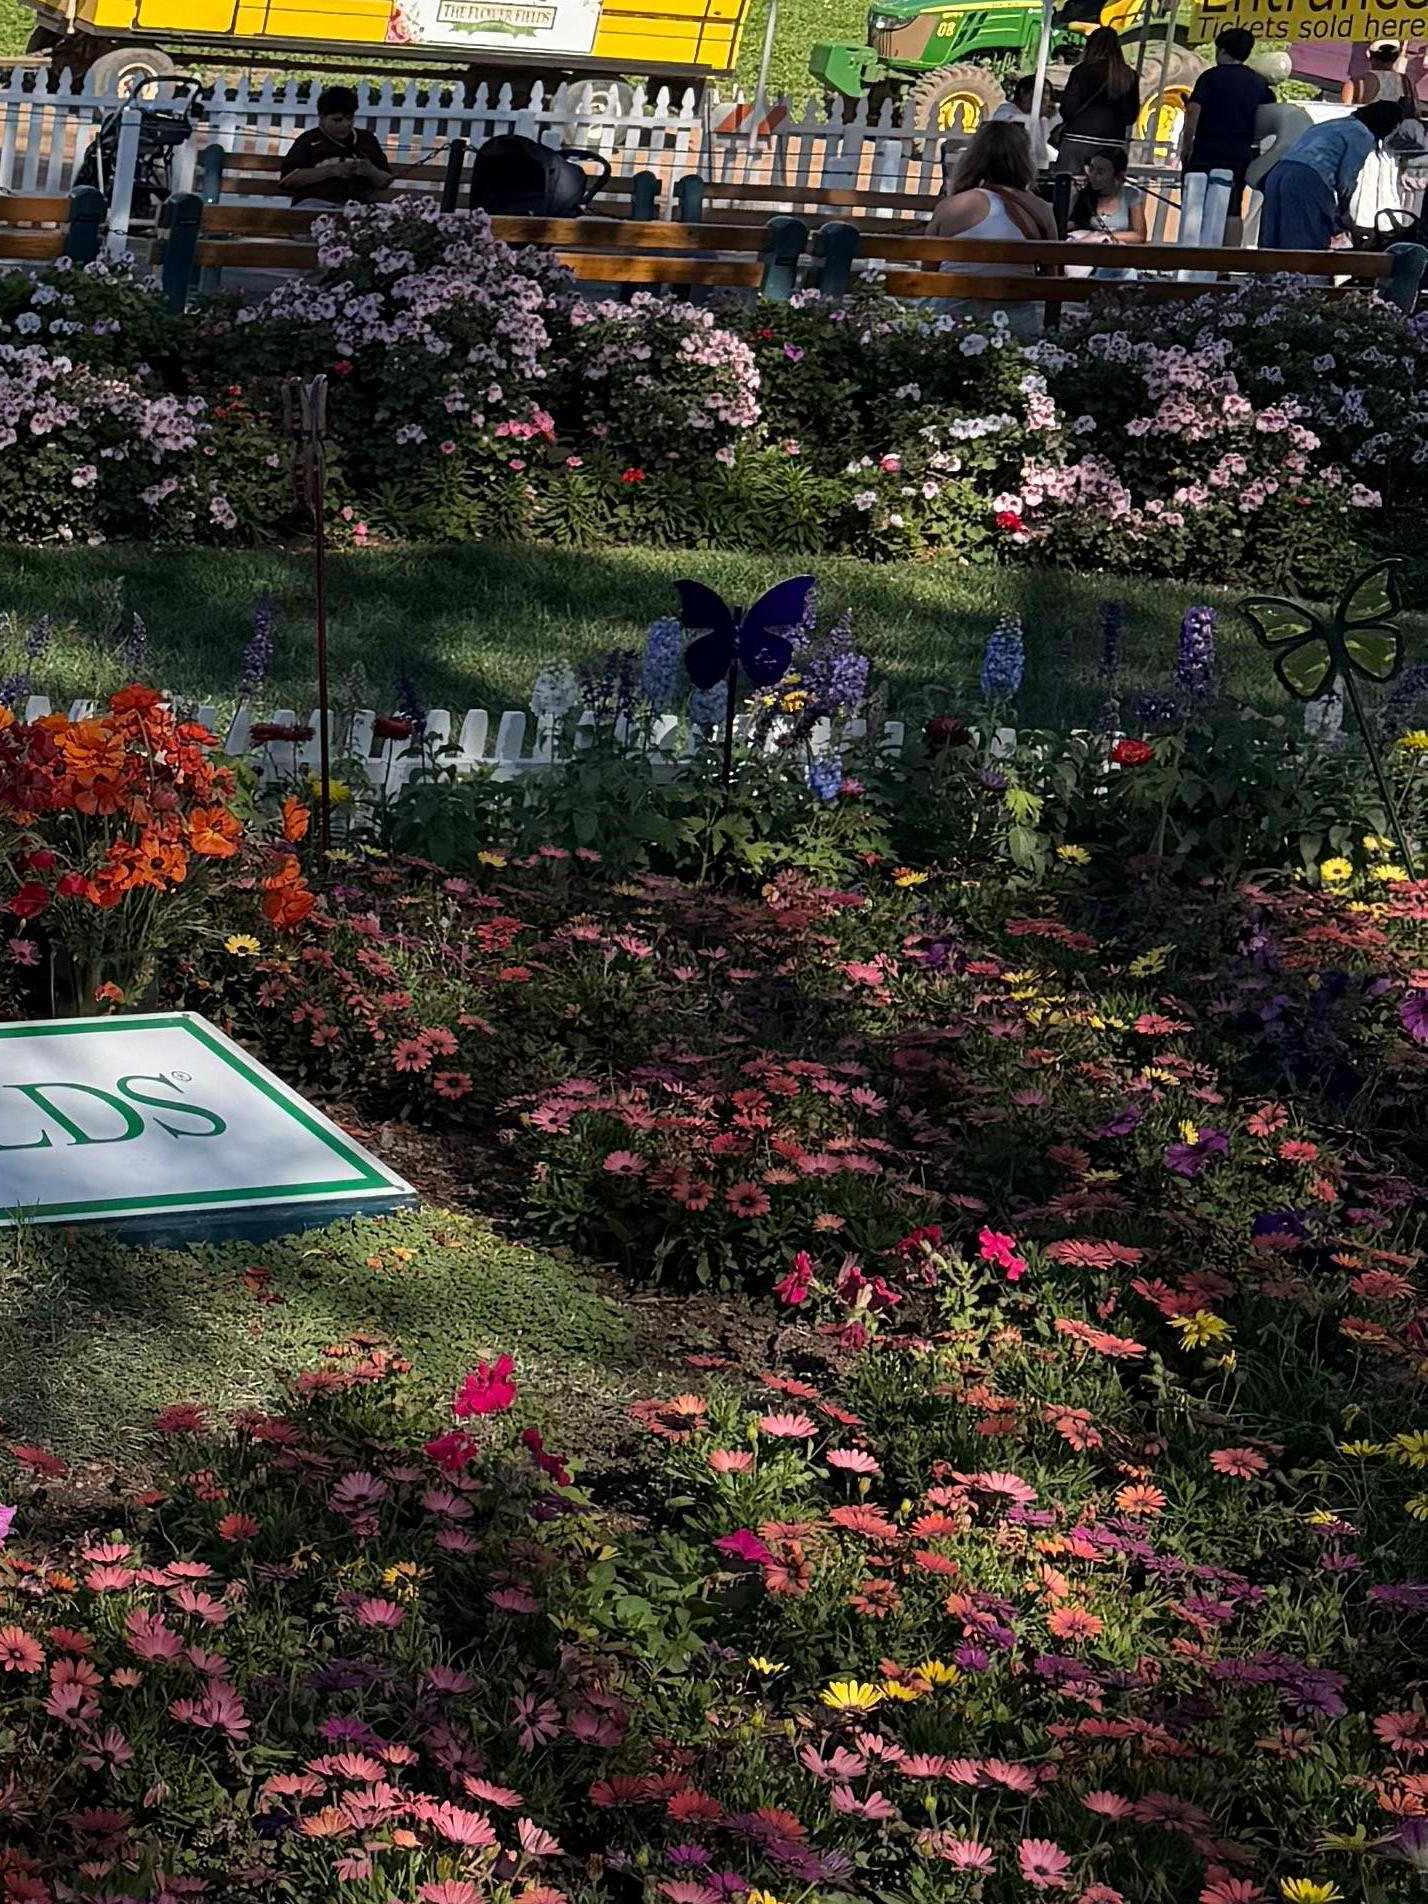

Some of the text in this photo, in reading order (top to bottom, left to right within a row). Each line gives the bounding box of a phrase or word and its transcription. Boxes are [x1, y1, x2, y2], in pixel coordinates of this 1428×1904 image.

[444, 4, 552, 24] THE FLOWER FIELDS
[1298, 13, 1354, 38] sold
[1365, 13, 1425, 37] here
